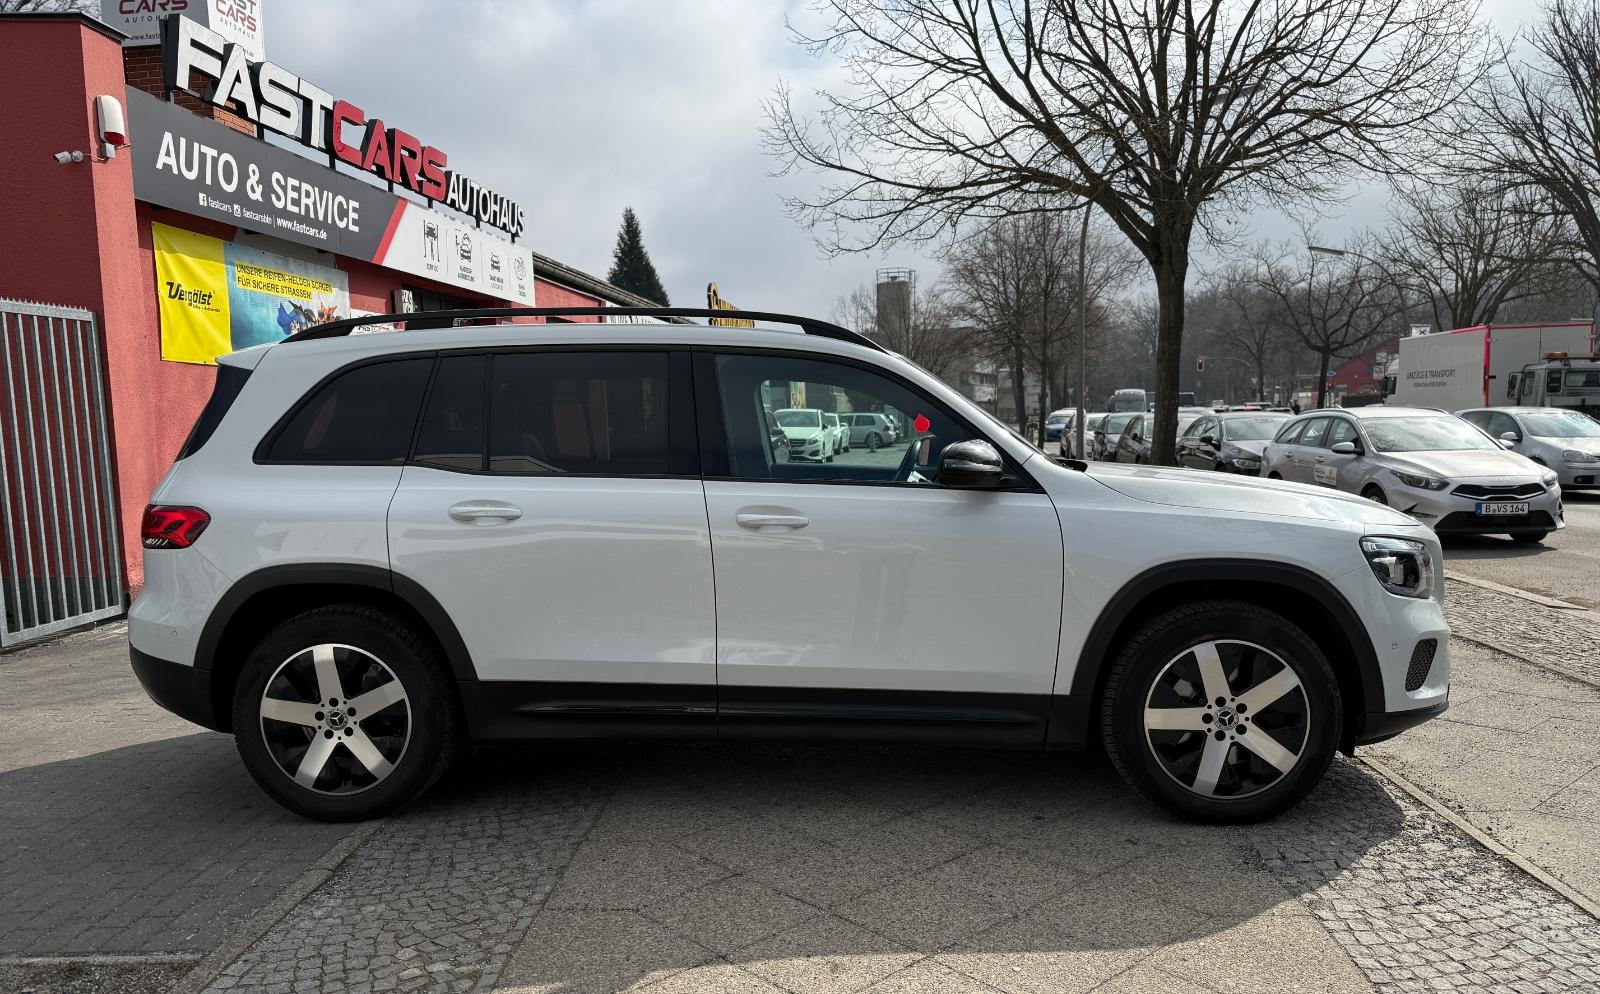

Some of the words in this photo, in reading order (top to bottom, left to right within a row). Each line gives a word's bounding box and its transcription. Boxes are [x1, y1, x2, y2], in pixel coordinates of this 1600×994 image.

[119, 0, 188, 14] CARS
[216, 0, 256, 32] CARS
[125, 15, 168, 23] AUTOHA
[156, 131, 239, 193] AUTO
[246, 163, 264, 202] &
[271, 171, 360, 232] SERVICE
[447, 171, 525, 237] AUTOHAUS
[208, 196, 232, 213] fastcars
[276, 217, 328, 240] www.fastcars.de
[236, 263, 263, 278] UNSERE
[237, 274, 251, 287] FÜR
[252, 279, 280, 293] SICHERE
[166, 281, 213, 307] Vergölst
[1429, 368, 1456, 379] TRANSPORT
[1485, 504, 1491, 513] B
[1497, 504, 1508, 513] VS
[1510, 504, 1525, 513] 164
